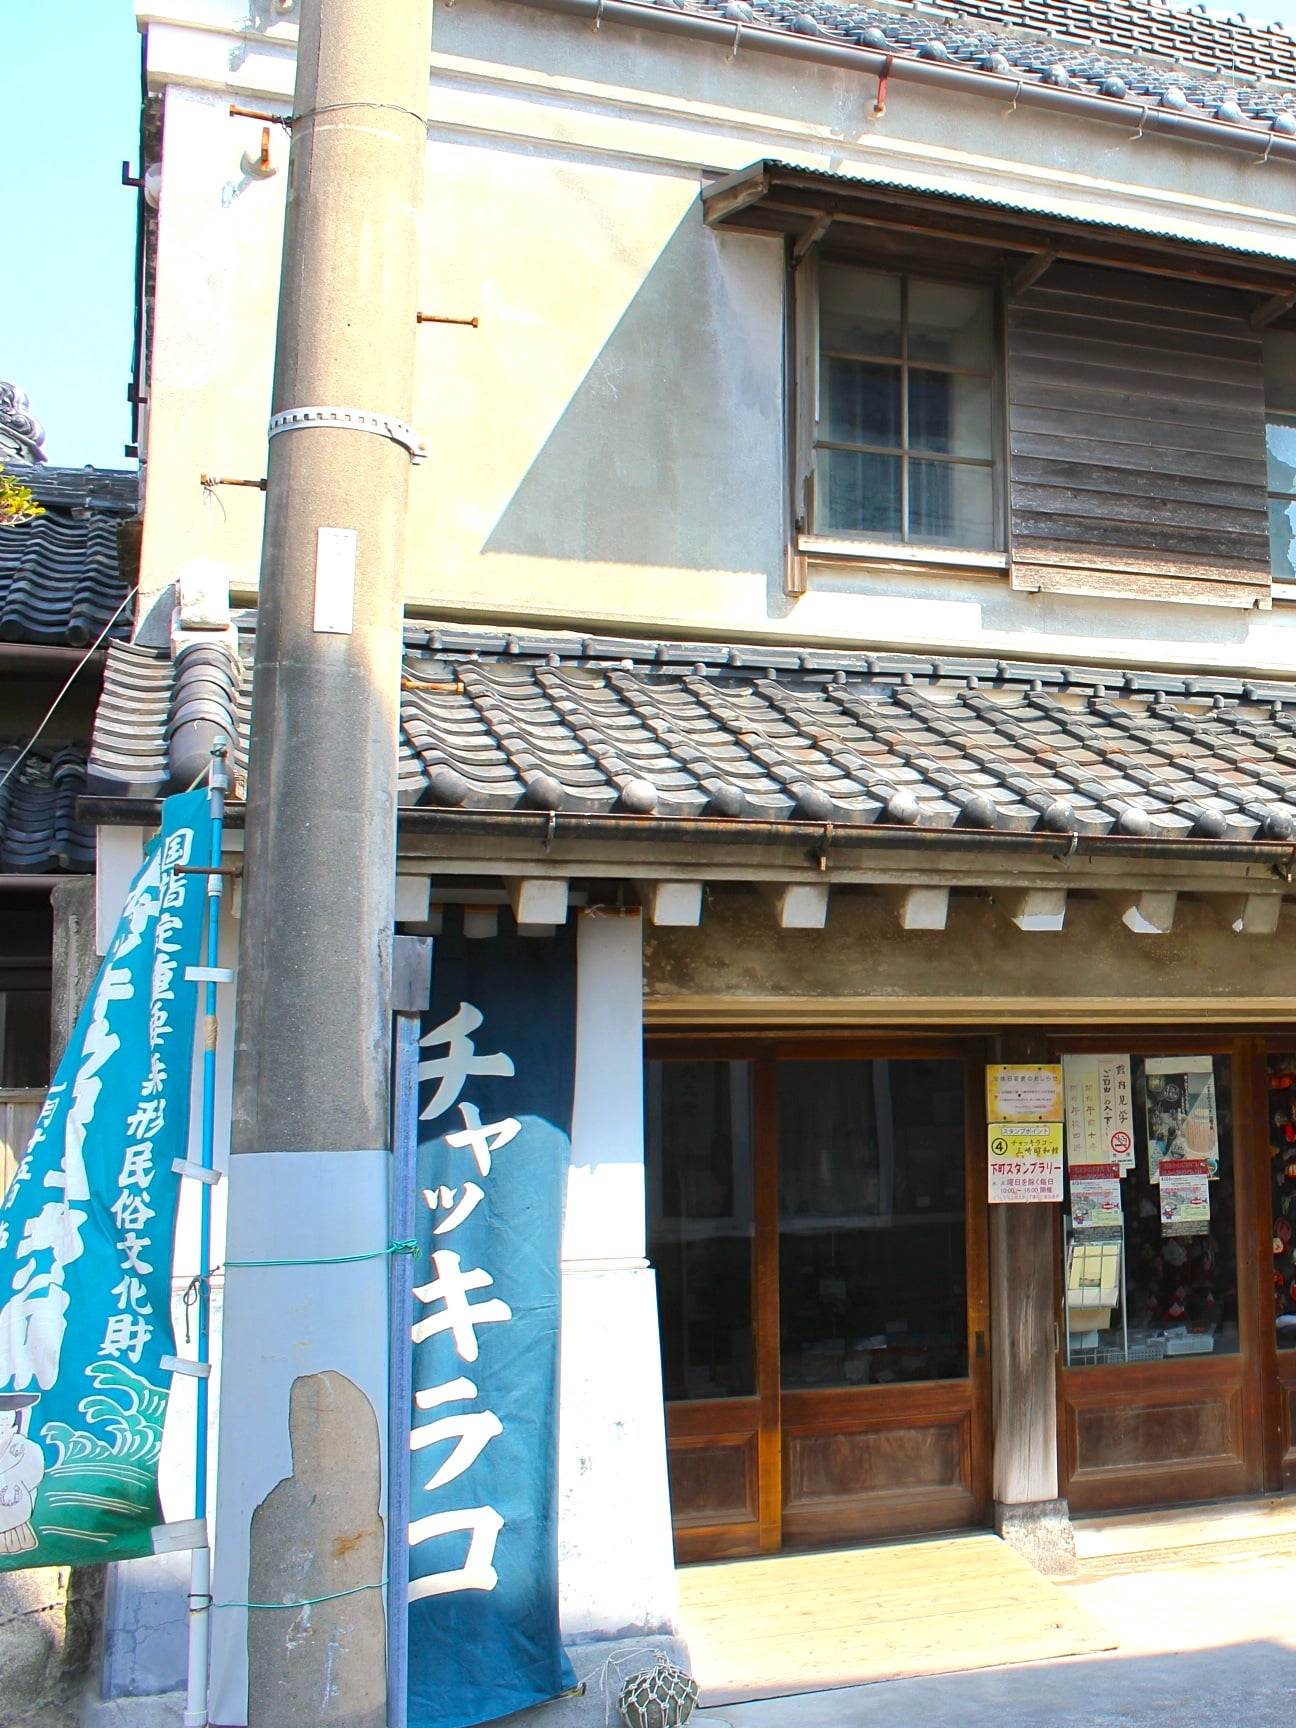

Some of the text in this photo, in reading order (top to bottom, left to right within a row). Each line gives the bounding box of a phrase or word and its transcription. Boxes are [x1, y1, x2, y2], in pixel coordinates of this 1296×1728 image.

[408, 1001, 515, 1603] チャッキラコ
[990, 1162, 1061, 1175] 下町スタンプラリー
